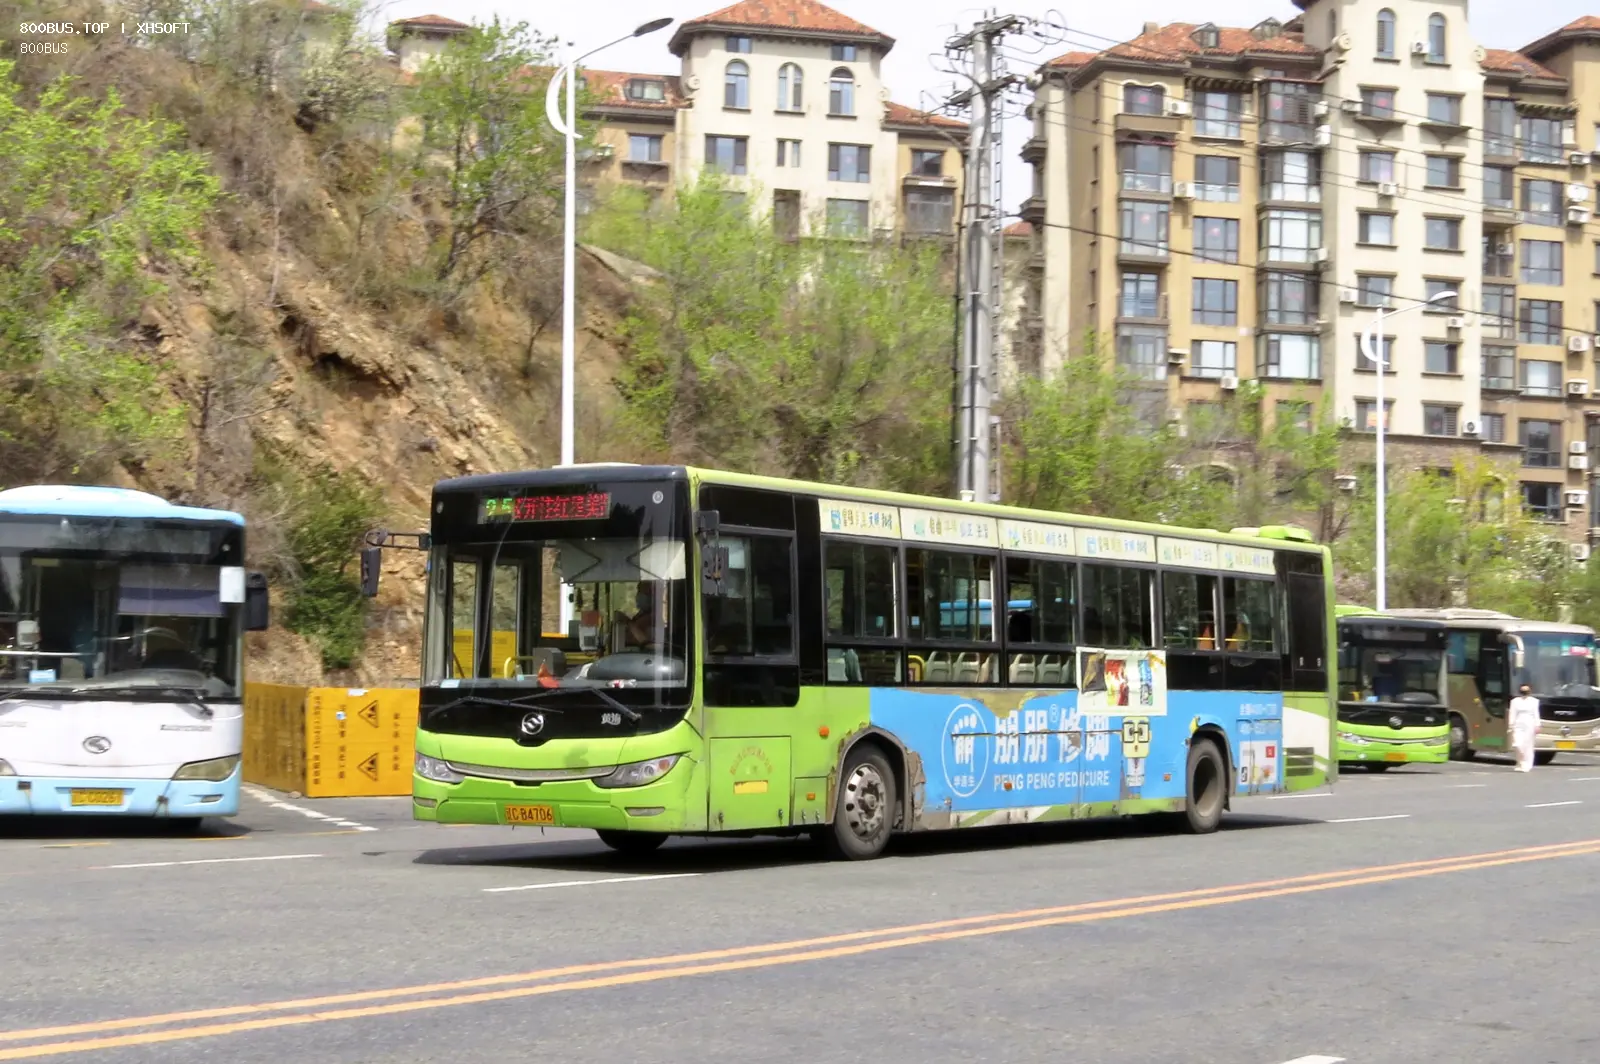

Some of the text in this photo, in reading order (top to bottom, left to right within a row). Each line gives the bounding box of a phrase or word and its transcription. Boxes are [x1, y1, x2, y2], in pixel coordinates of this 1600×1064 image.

[994, 770, 1111, 792] PENG PENG PEDICURE
